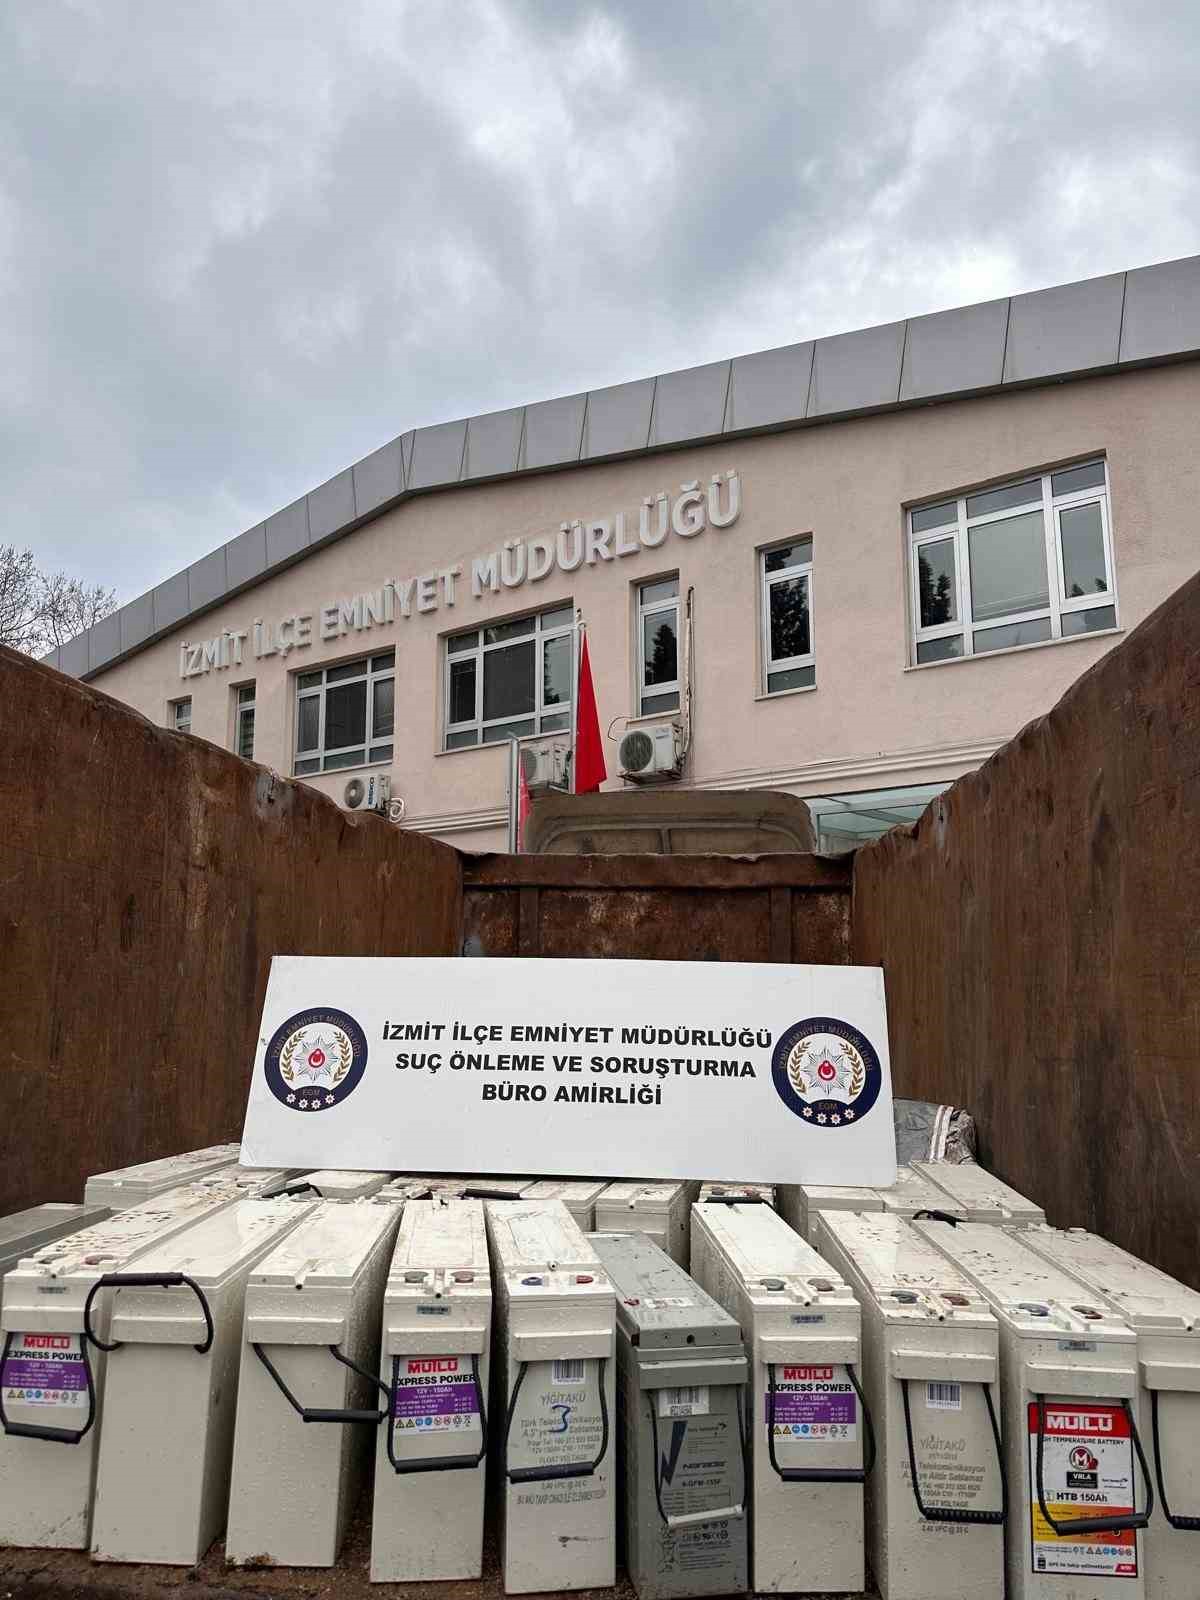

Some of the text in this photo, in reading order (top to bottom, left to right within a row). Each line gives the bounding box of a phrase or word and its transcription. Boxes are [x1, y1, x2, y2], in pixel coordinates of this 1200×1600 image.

[179, 468, 742, 680] İZMİT İLÇE EMNİYET MÜDÜRLÜĞÜ
[383, 1021, 772, 1049] İZMİT İLÇE EMNİYET MÜDÜRLÜĞÜ
[396, 1050, 757, 1079] SUÇ ÖNLEME VE SORUŞTURMA
[482, 1080, 662, 1105] BÜRO AMİRLİĞİ
[23, 1334, 70, 1349] MUTLU
[408, 1357, 459, 1374] MUTLU
[784, 1366, 833, 1381] MUTLU
[815, 1383, 852, 1392] POWER
[1046, 1411, 1113, 1431] MUTLU
[1072, 1473, 1092, 1481] VRLA
[1056, 1492, 1107, 1502] HTB 150Ah
